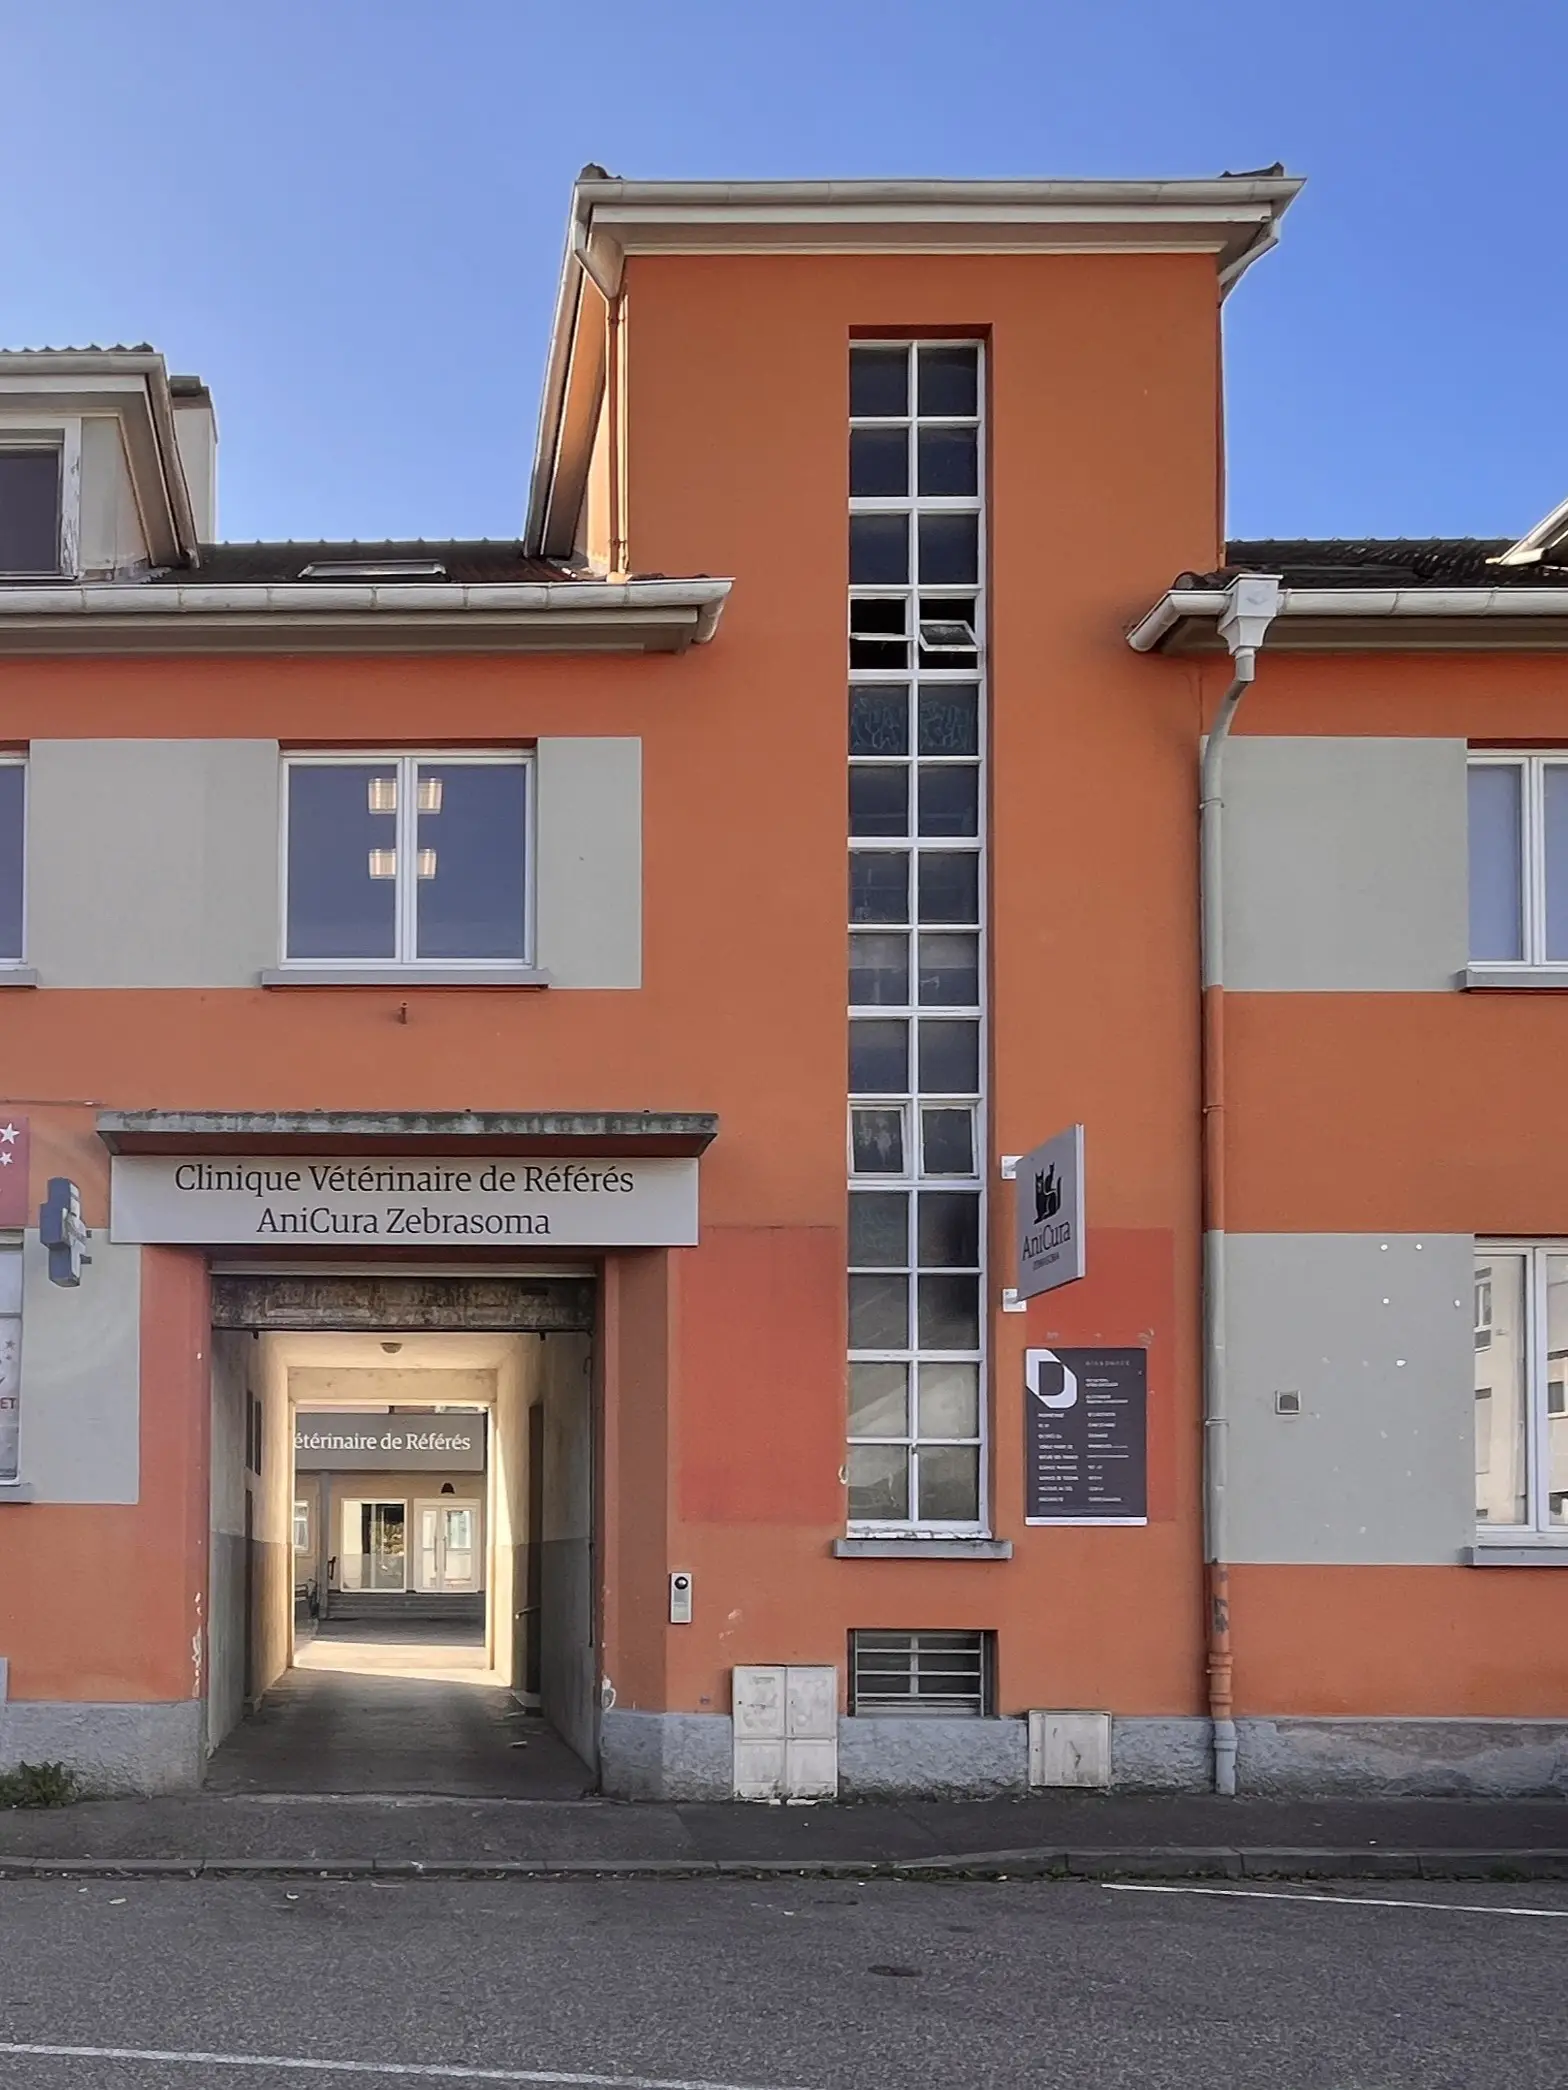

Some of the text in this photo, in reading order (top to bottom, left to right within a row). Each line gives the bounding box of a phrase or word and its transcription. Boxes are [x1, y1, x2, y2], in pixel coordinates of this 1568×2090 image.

[175, 1164, 634, 1198] Clinique Vétérinaire de Référés
[256, 1207, 551, 1235] AniCura Zebrasoma
[1022, 1221, 1071, 1261] AniCura
[293, 1432, 471, 1451] étérinaire de Référés
